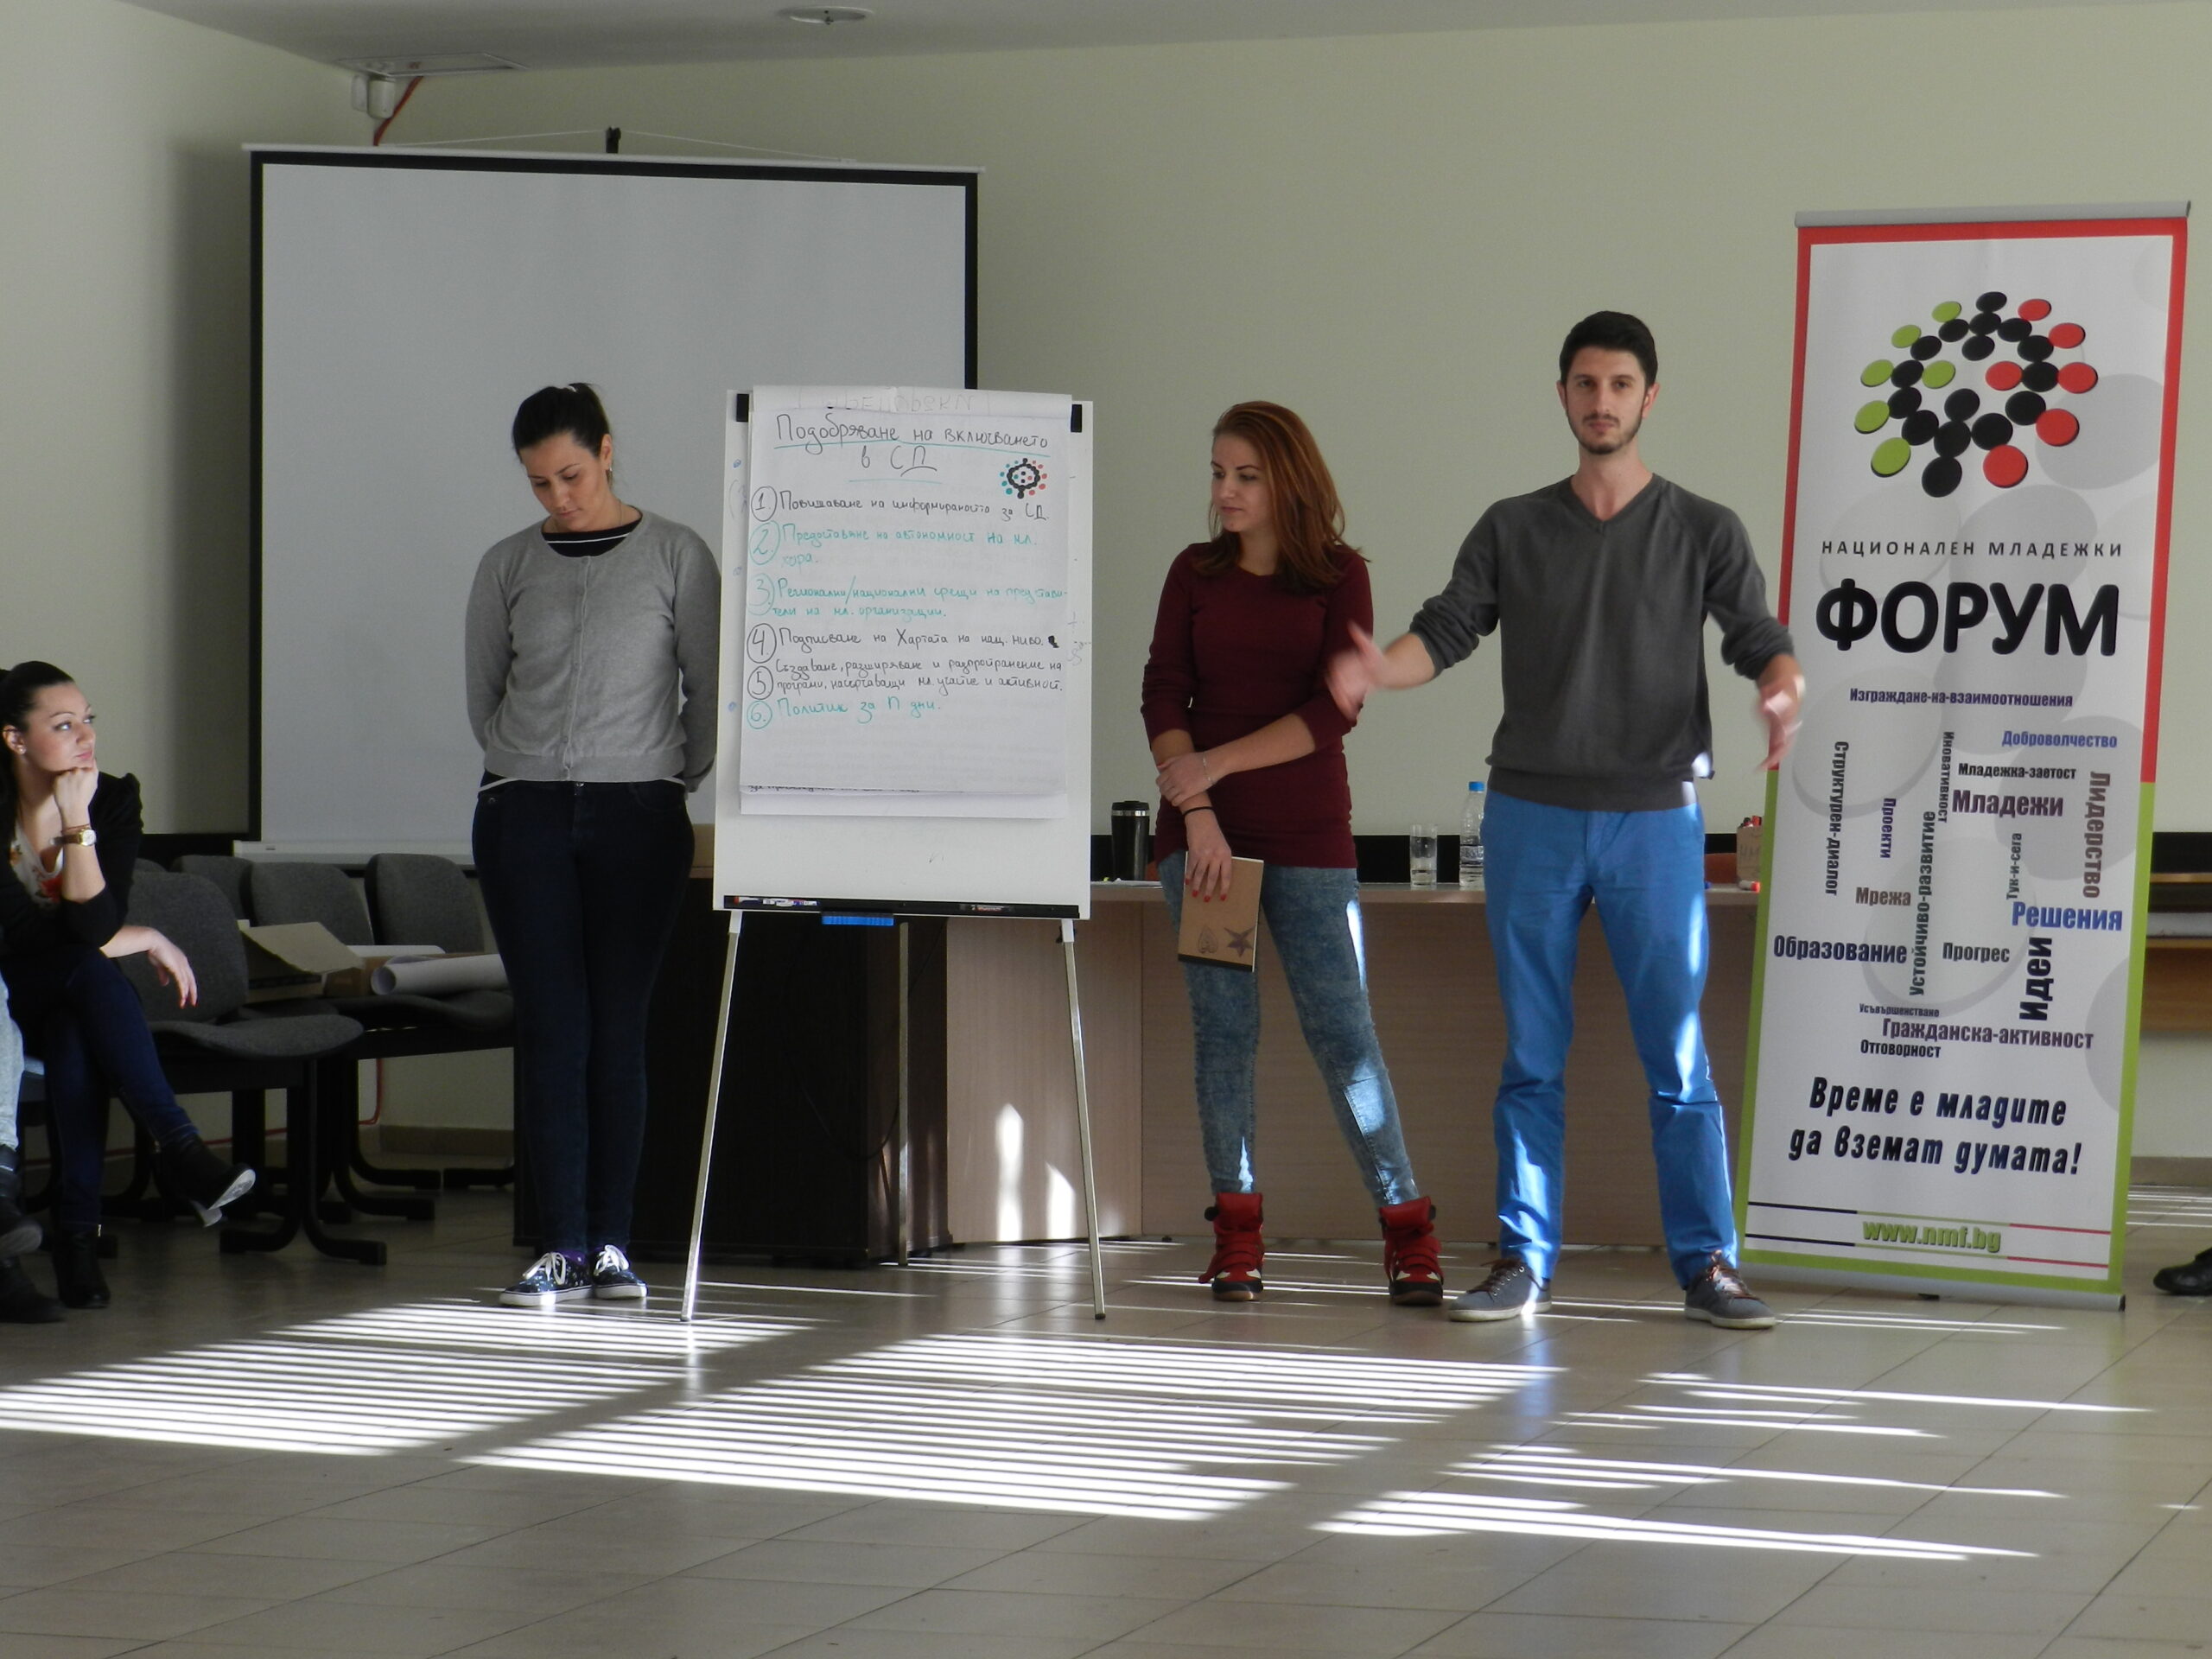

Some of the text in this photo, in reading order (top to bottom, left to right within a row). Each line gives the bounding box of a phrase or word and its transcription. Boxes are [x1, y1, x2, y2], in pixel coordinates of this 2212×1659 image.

[776, 412, 1048, 455] Подобряване на включването
[779, 490, 863, 511] Повишаване
[871, 499, 885, 508] на
[1001, 508, 1014, 522] за
[876, 531, 888, 540] на
[1821, 540, 2122, 559] НАЦИОНАЛЕН МЛАДЕЖКИ
[806, 607, 820, 616] на
[1815, 578, 2120, 657] ФОРУМ
[779, 627, 861, 654] Подписване
[896, 628, 949, 650] Хартата
[857, 701, 876, 724] за
[1850, 688, 2073, 707] Изграждане-на-взаимоотношения
[2002, 731, 2118, 748] Доброволчество
[1938, 731, 1955, 823] Иновативност
[1958, 763, 2077, 780] Младежка-заетост
[1826, 741, 1850, 895] Структурен-диалог
[1952, 789, 2064, 818] Младежи
[1879, 798, 1897, 859] Проекти
[2082, 771, 2111, 899] Лидерство
[2005, 833, 2023, 899] Тук-и-сега
[1855, 887, 1912, 906] Мрежа
[1909, 810, 1936, 995] Устойчиво-развитие
[2012, 901, 2123, 931] Решения
[1774, 935, 1907, 964] Образование
[1942, 942, 2011, 963] Прогрес
[2018, 937, 2054, 1021] Идеи
[1859, 1003, 1940, 1018] Усъвършенстване
[1860, 1039, 1942, 1058] Отговорност
[1882, 1018, 2094, 1049] Гражданска-активност
[1808, 1077, 2067, 1129] Време е младите
[1788, 1125, 2082, 1176] да вземат думата!
[1862, 1221, 2002, 1253] www.nmf.bg
